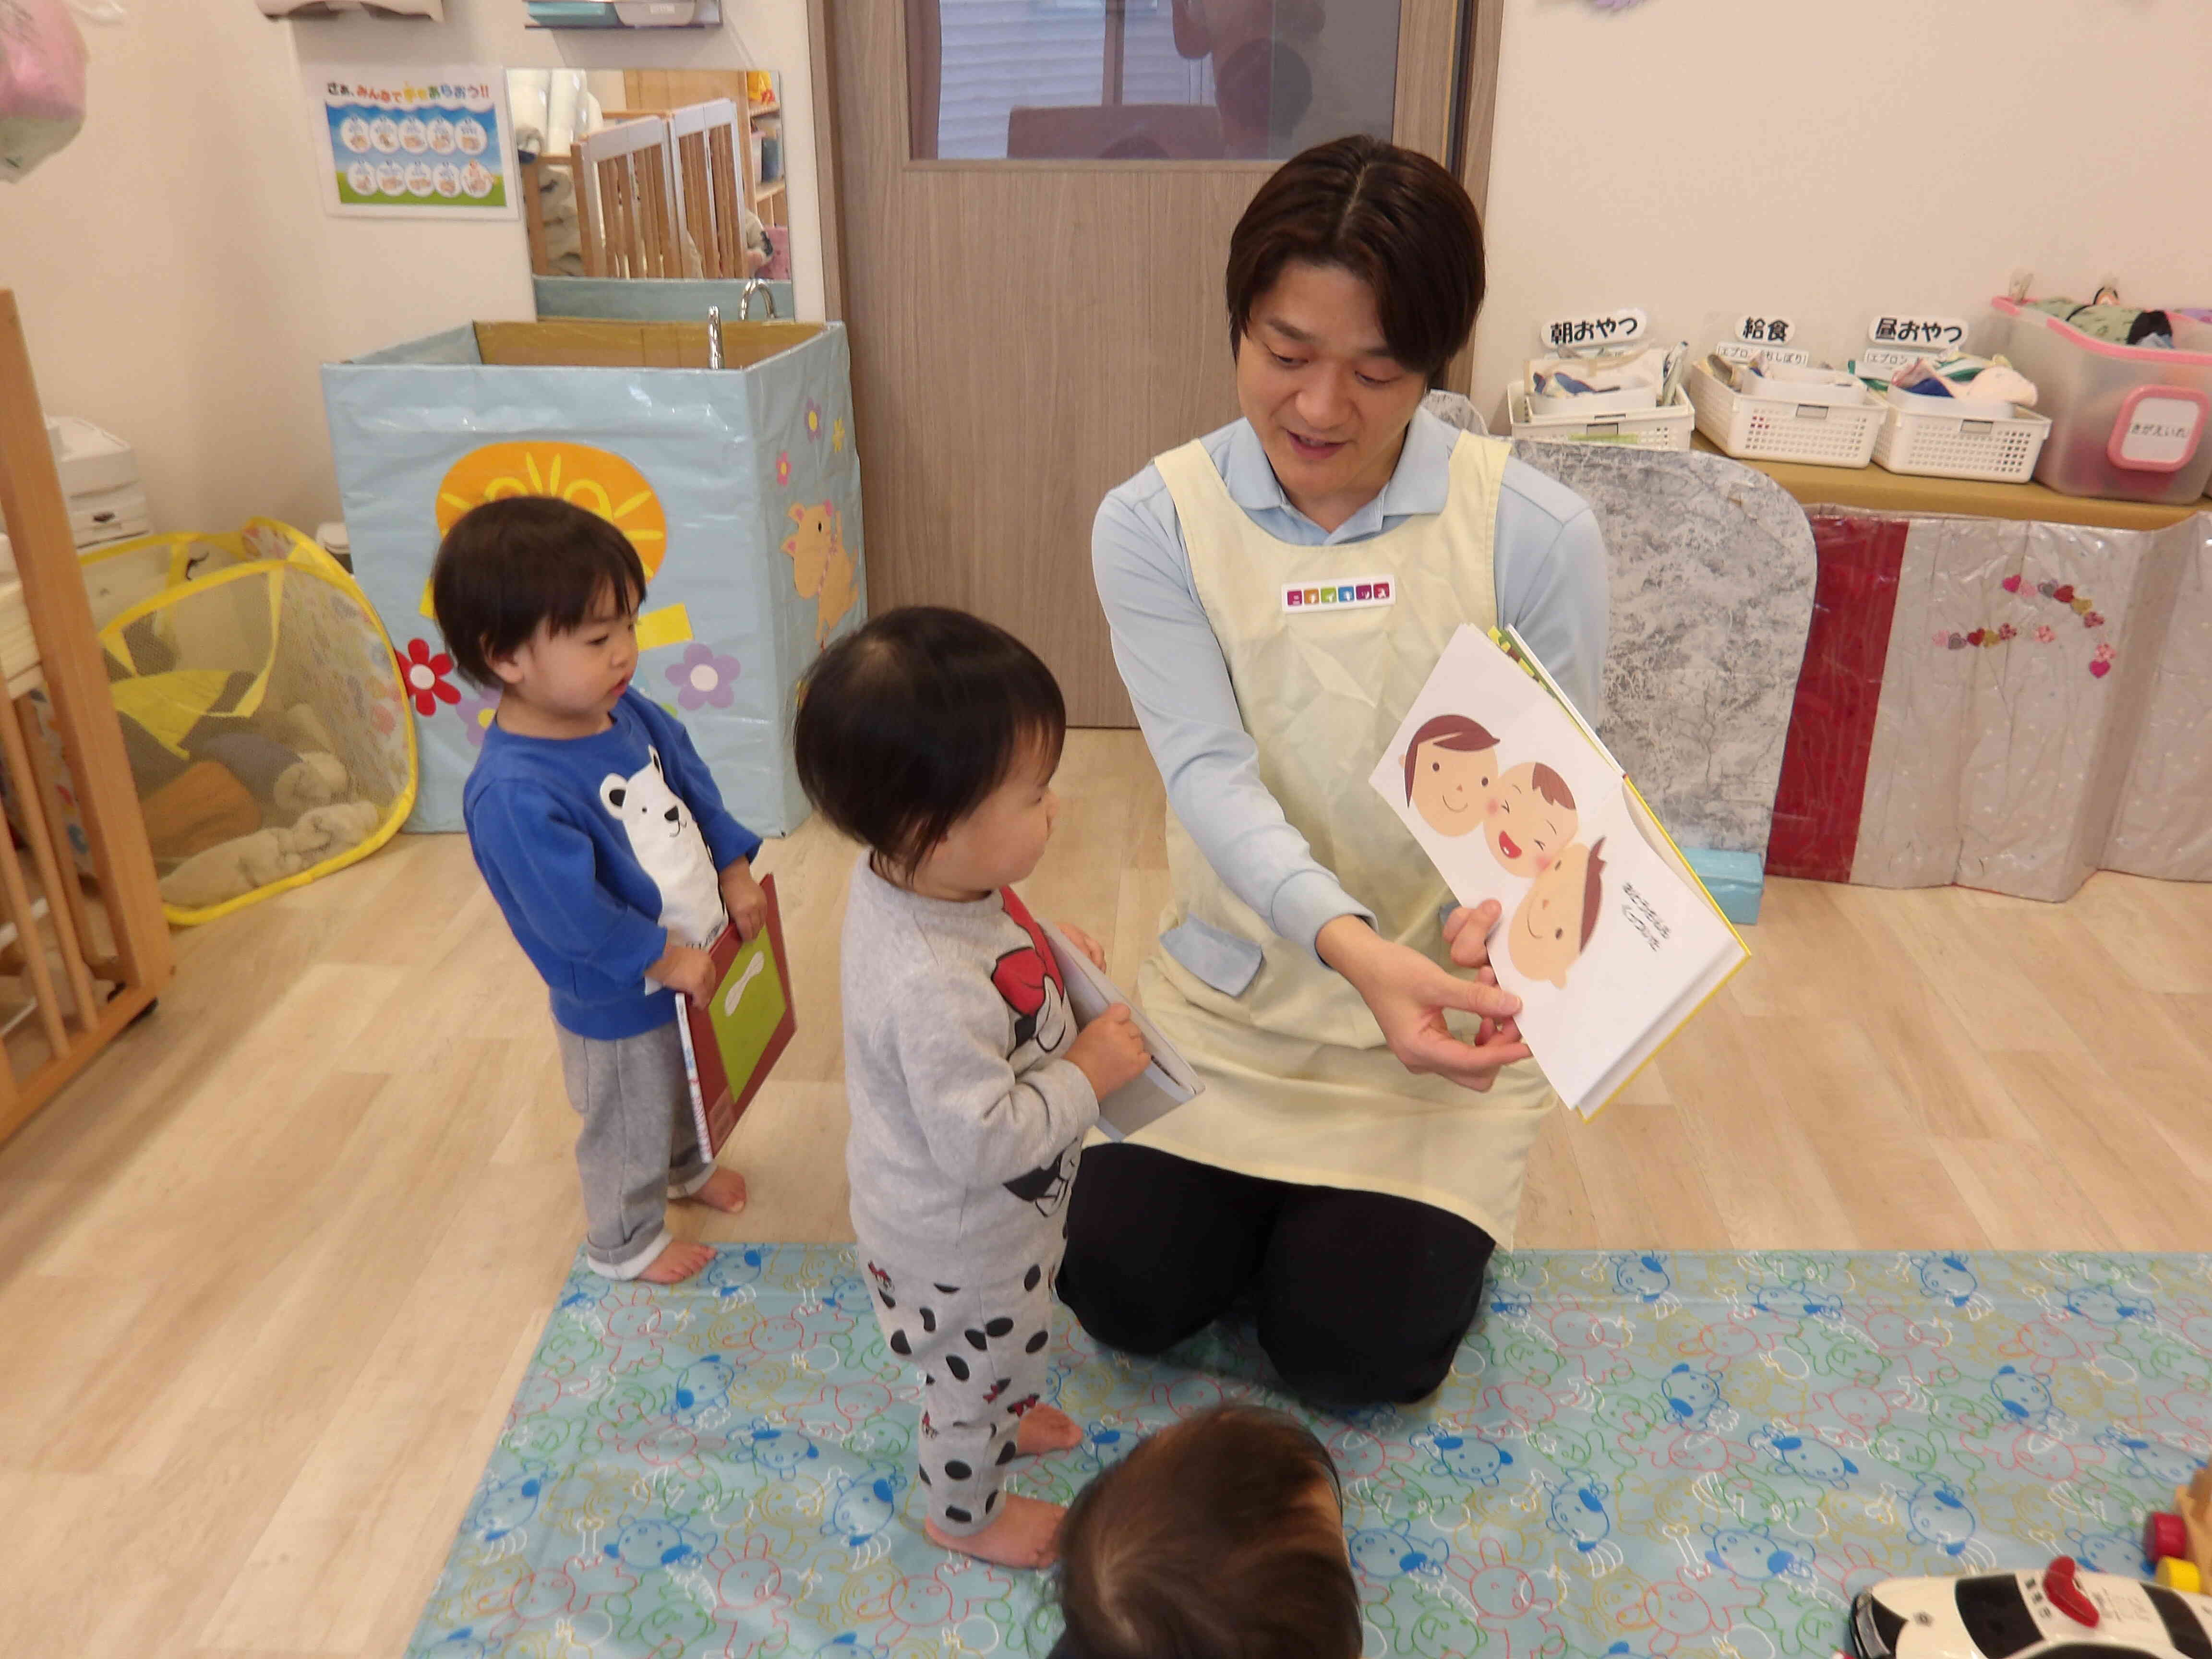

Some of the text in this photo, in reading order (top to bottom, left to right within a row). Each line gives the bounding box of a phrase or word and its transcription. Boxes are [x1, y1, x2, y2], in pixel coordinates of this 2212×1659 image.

[1551, 318, 1638, 344] 朝おやつ
[1743, 316, 1789, 341] 給食
[1875, 318, 1962, 342] 昼おやつ
